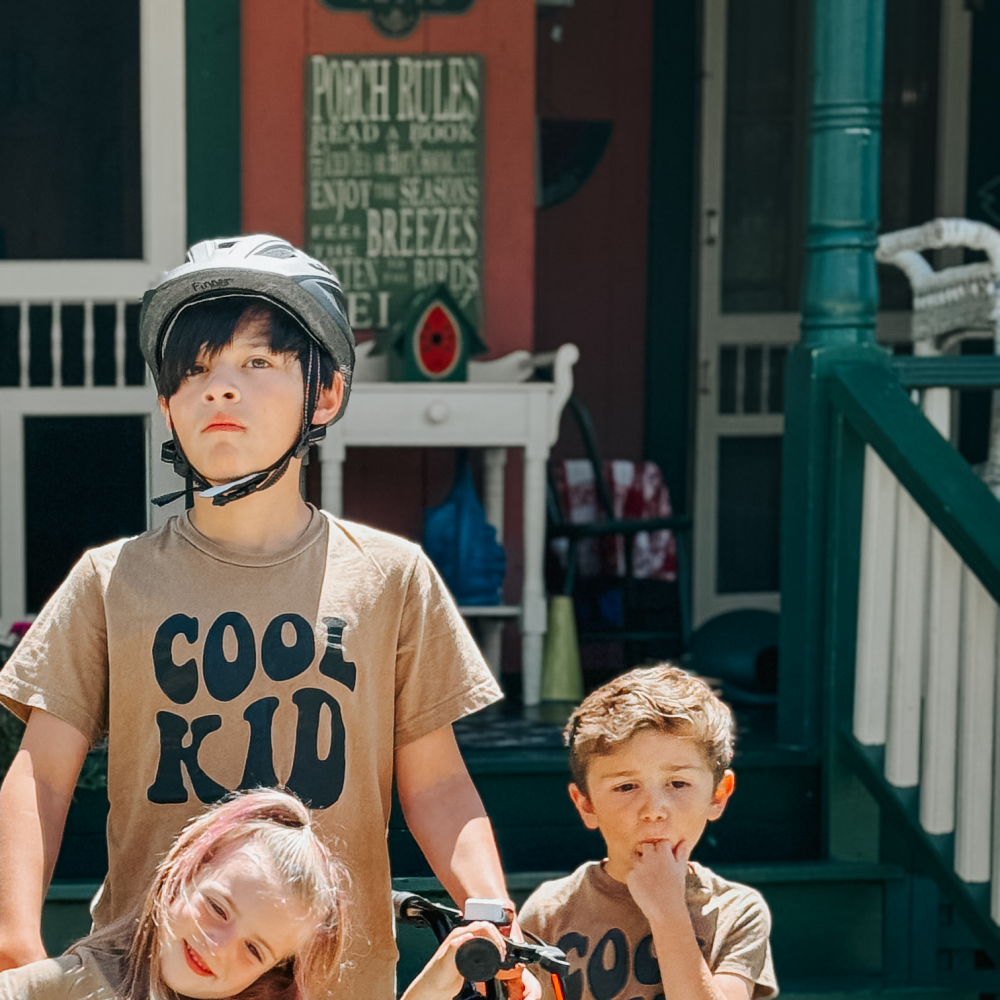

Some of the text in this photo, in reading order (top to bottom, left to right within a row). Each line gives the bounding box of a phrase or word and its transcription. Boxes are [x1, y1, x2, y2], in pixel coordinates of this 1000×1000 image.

[311, 55, 479, 122] PORCH RULES
[367, 208, 477, 257] BREEZES
[152, 611, 357, 704] COOL
[147, 687, 346, 810] KID
